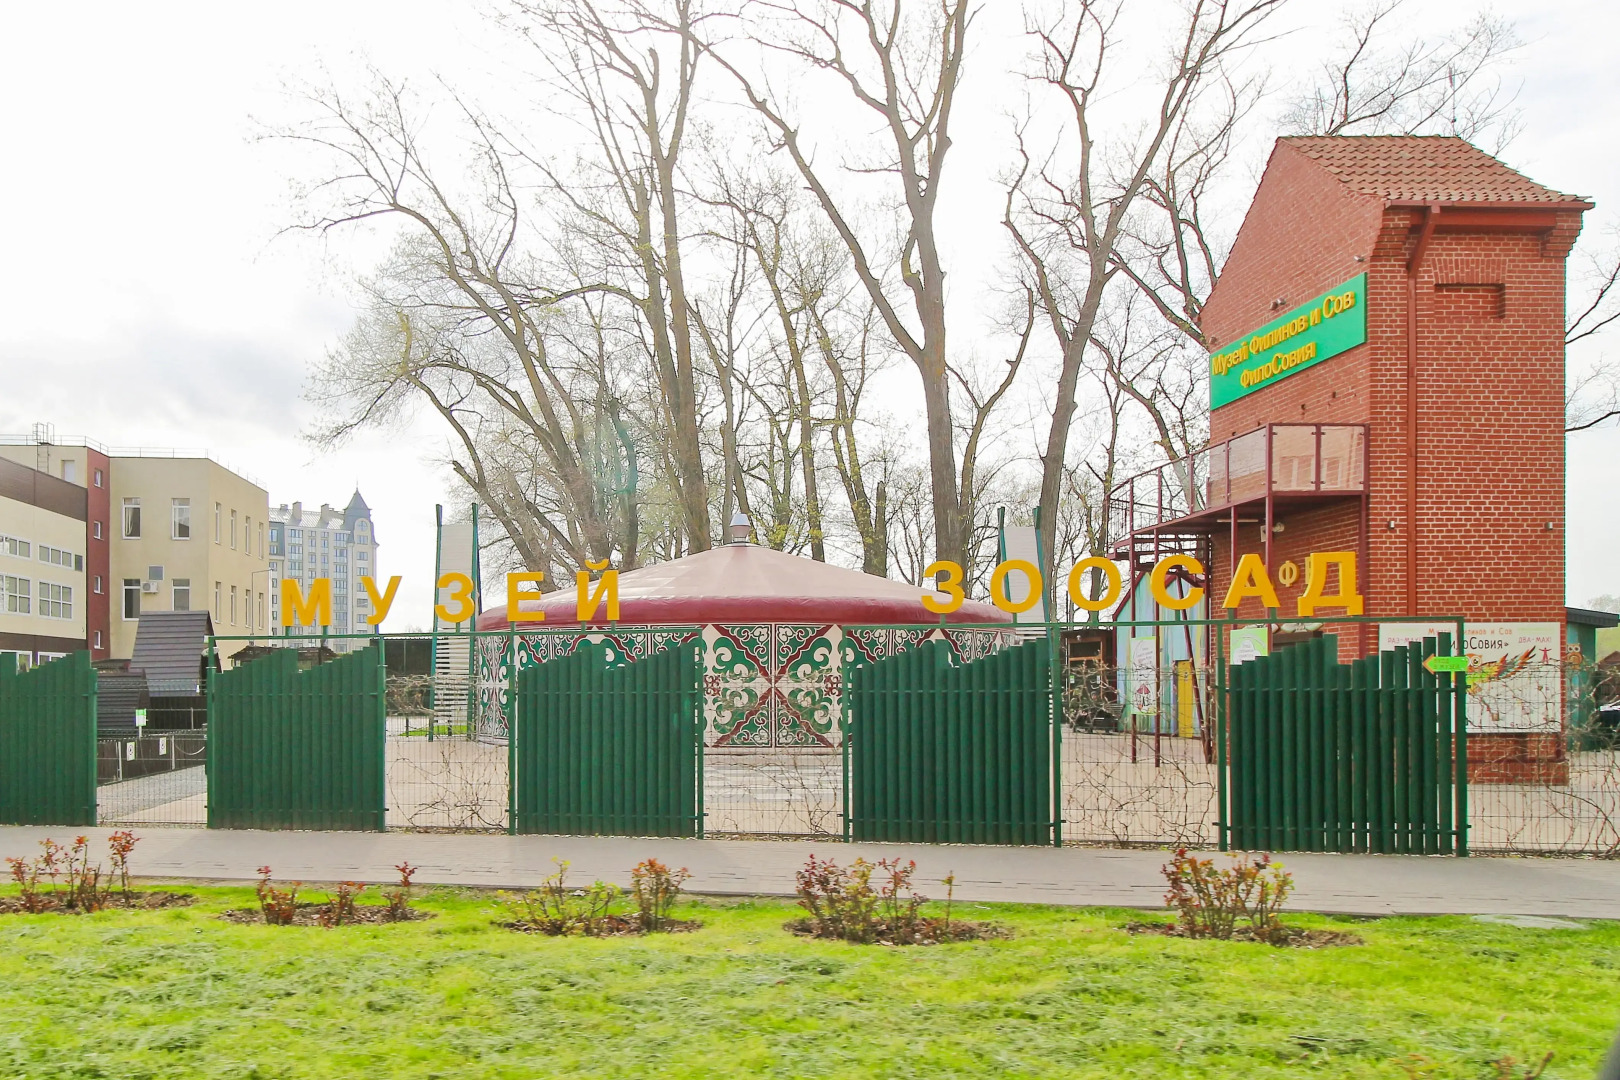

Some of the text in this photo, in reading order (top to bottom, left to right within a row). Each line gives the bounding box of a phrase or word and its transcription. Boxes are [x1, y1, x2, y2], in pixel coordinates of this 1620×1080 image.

[1212, 291, 1356, 376] Музей Филинов и Сов
[1240, 342, 1317, 388] ФилоСовия
[281, 558, 620, 627] МУЗЕЙ
